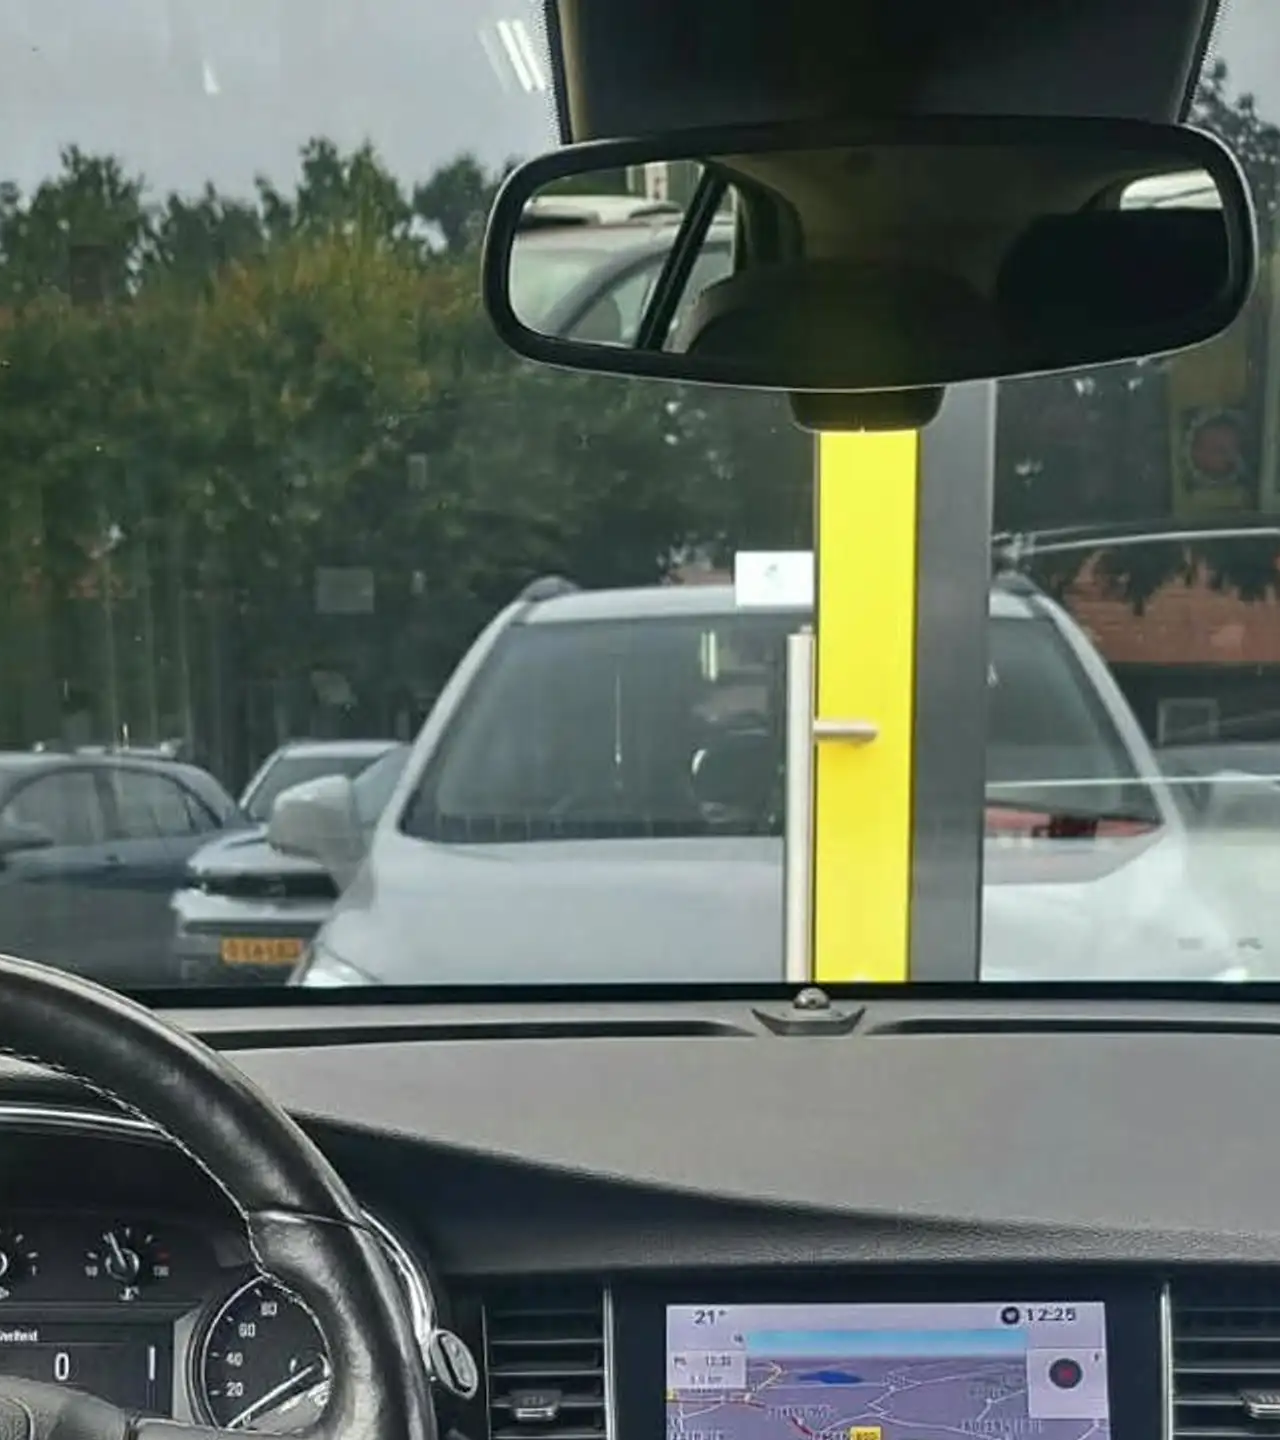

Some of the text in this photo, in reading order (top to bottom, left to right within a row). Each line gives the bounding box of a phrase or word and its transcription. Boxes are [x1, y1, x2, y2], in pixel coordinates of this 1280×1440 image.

[54, 1351, 70, 1381] 0
[226, 1351, 244, 1367] 40
[226, 1381, 244, 1397] 20
